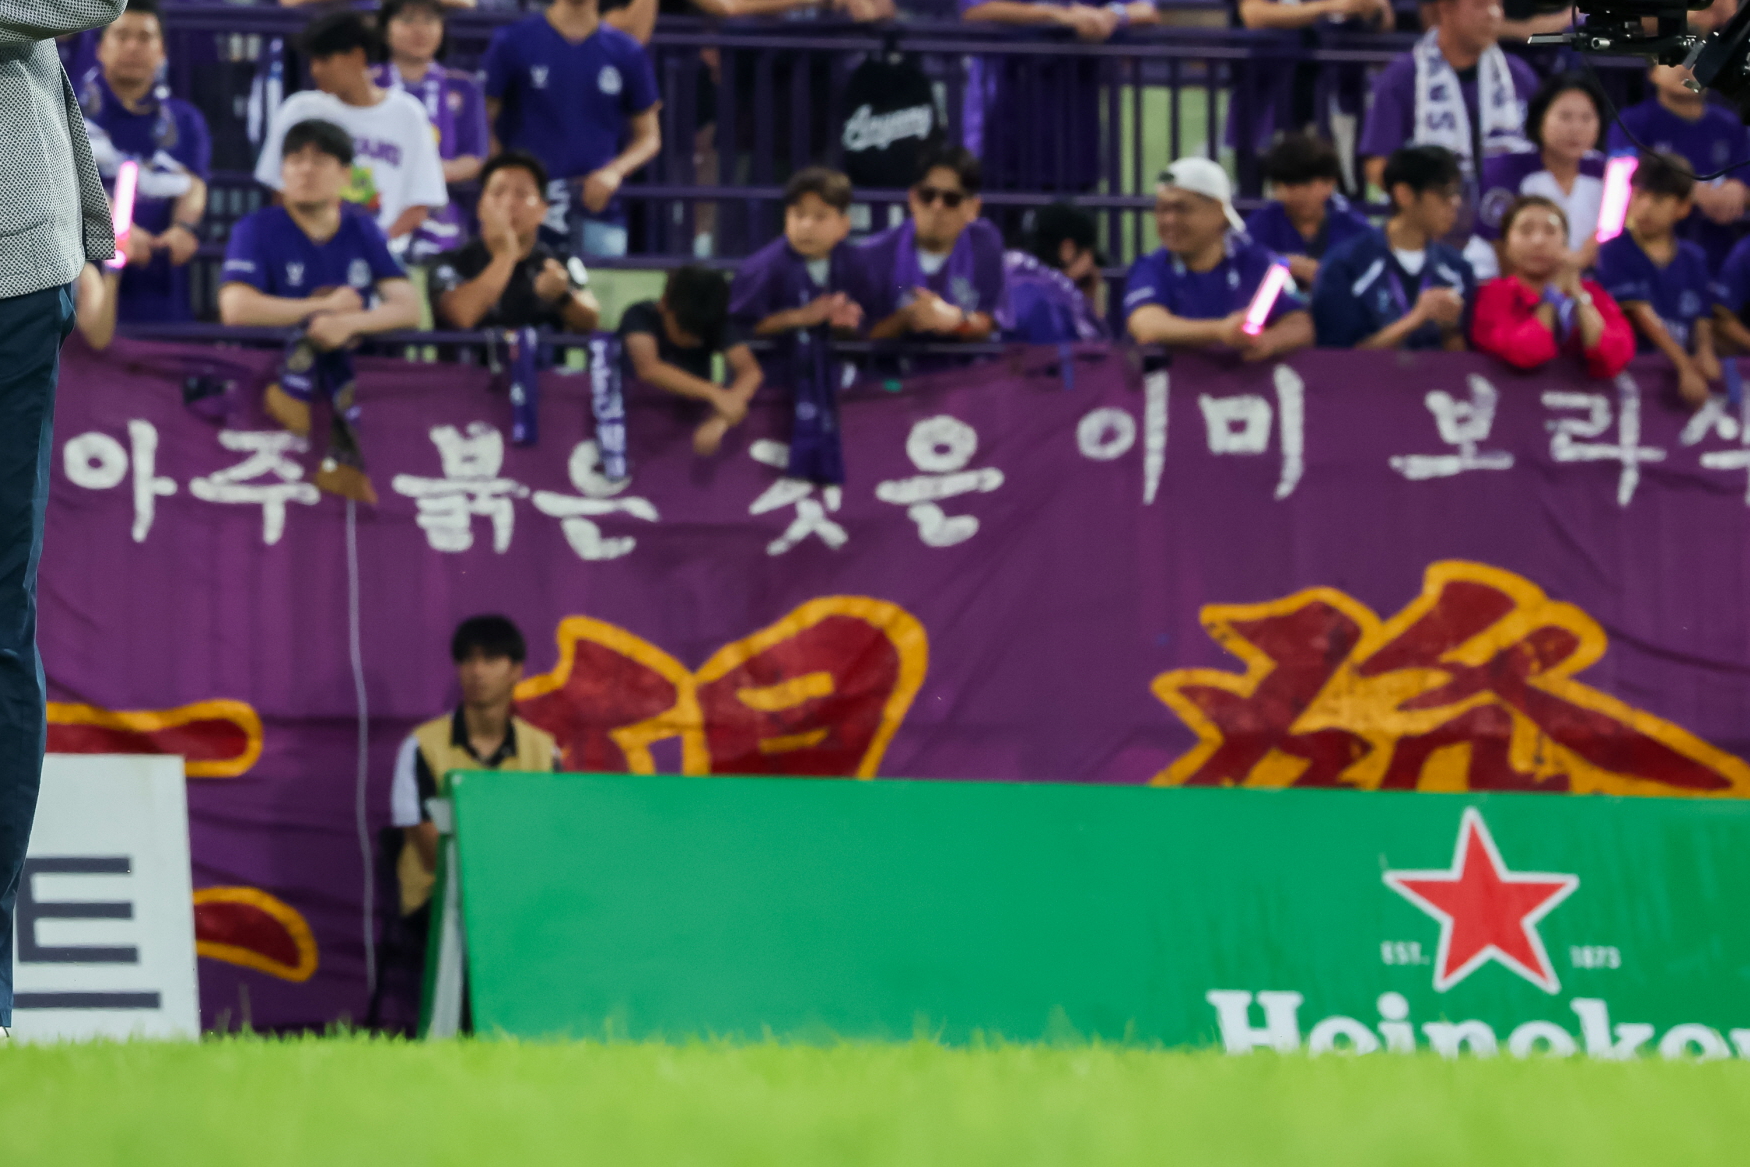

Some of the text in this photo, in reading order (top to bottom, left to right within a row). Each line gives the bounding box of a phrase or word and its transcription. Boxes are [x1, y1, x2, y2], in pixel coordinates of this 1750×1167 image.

[63, 419, 321, 545] 아주
[392, 422, 659, 561] 붉은
[1077, 363, 1306, 505] 이미
[1205, 989, 1750, 1061] Heineke
